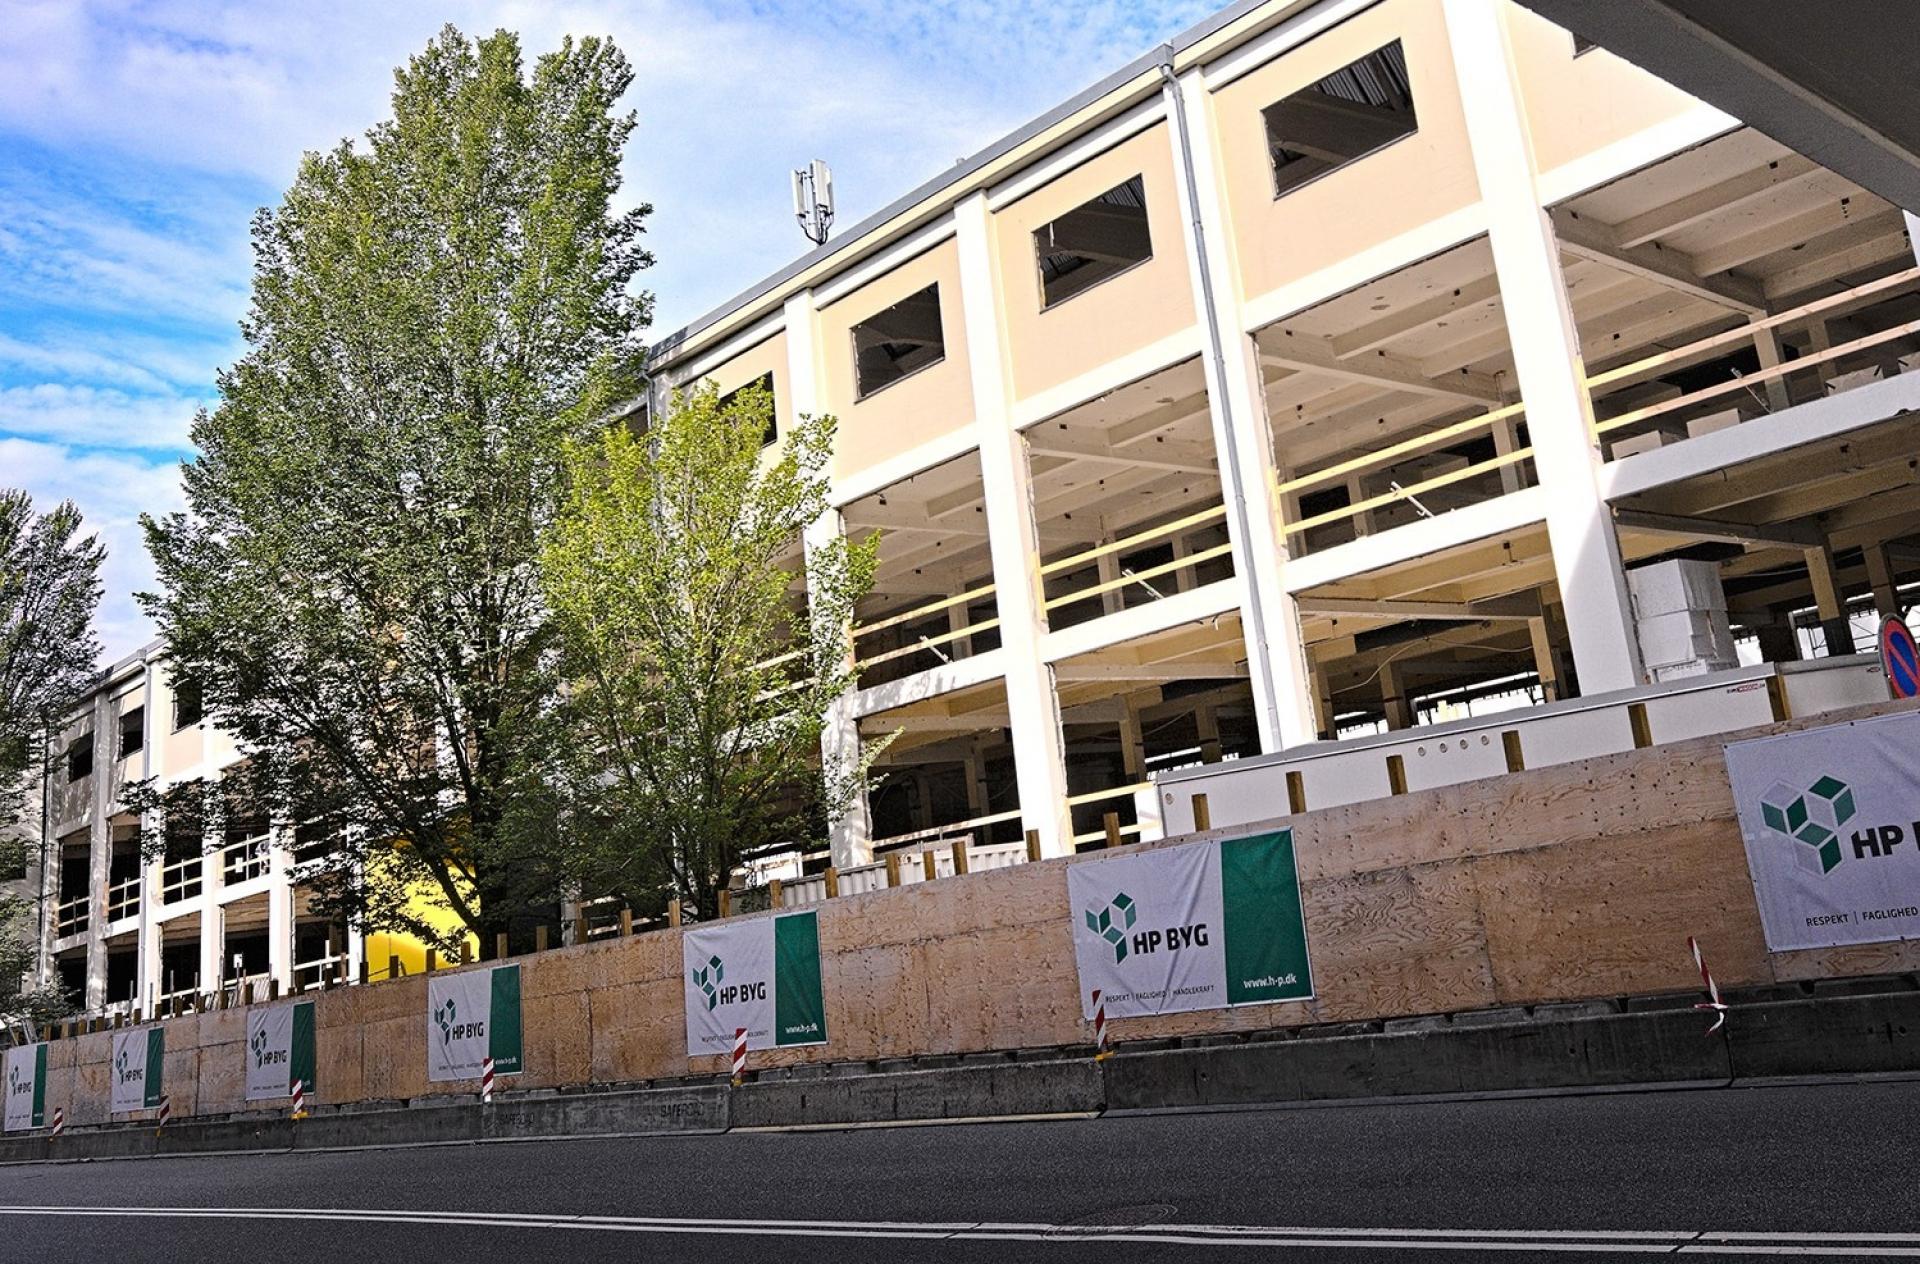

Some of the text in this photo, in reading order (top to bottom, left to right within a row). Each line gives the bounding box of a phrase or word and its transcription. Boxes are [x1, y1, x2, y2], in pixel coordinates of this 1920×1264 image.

[1851, 825, 1904, 859] HP
[1806, 906, 1919, 927] RESPEKT FAGLIGHED
[1133, 923, 1209, 955] HP BYG
[1243, 973, 1297, 989] www.h-p.dk
[720, 981, 766, 1005] HP BYG
[452, 1022, 484, 1040] HP BYG
